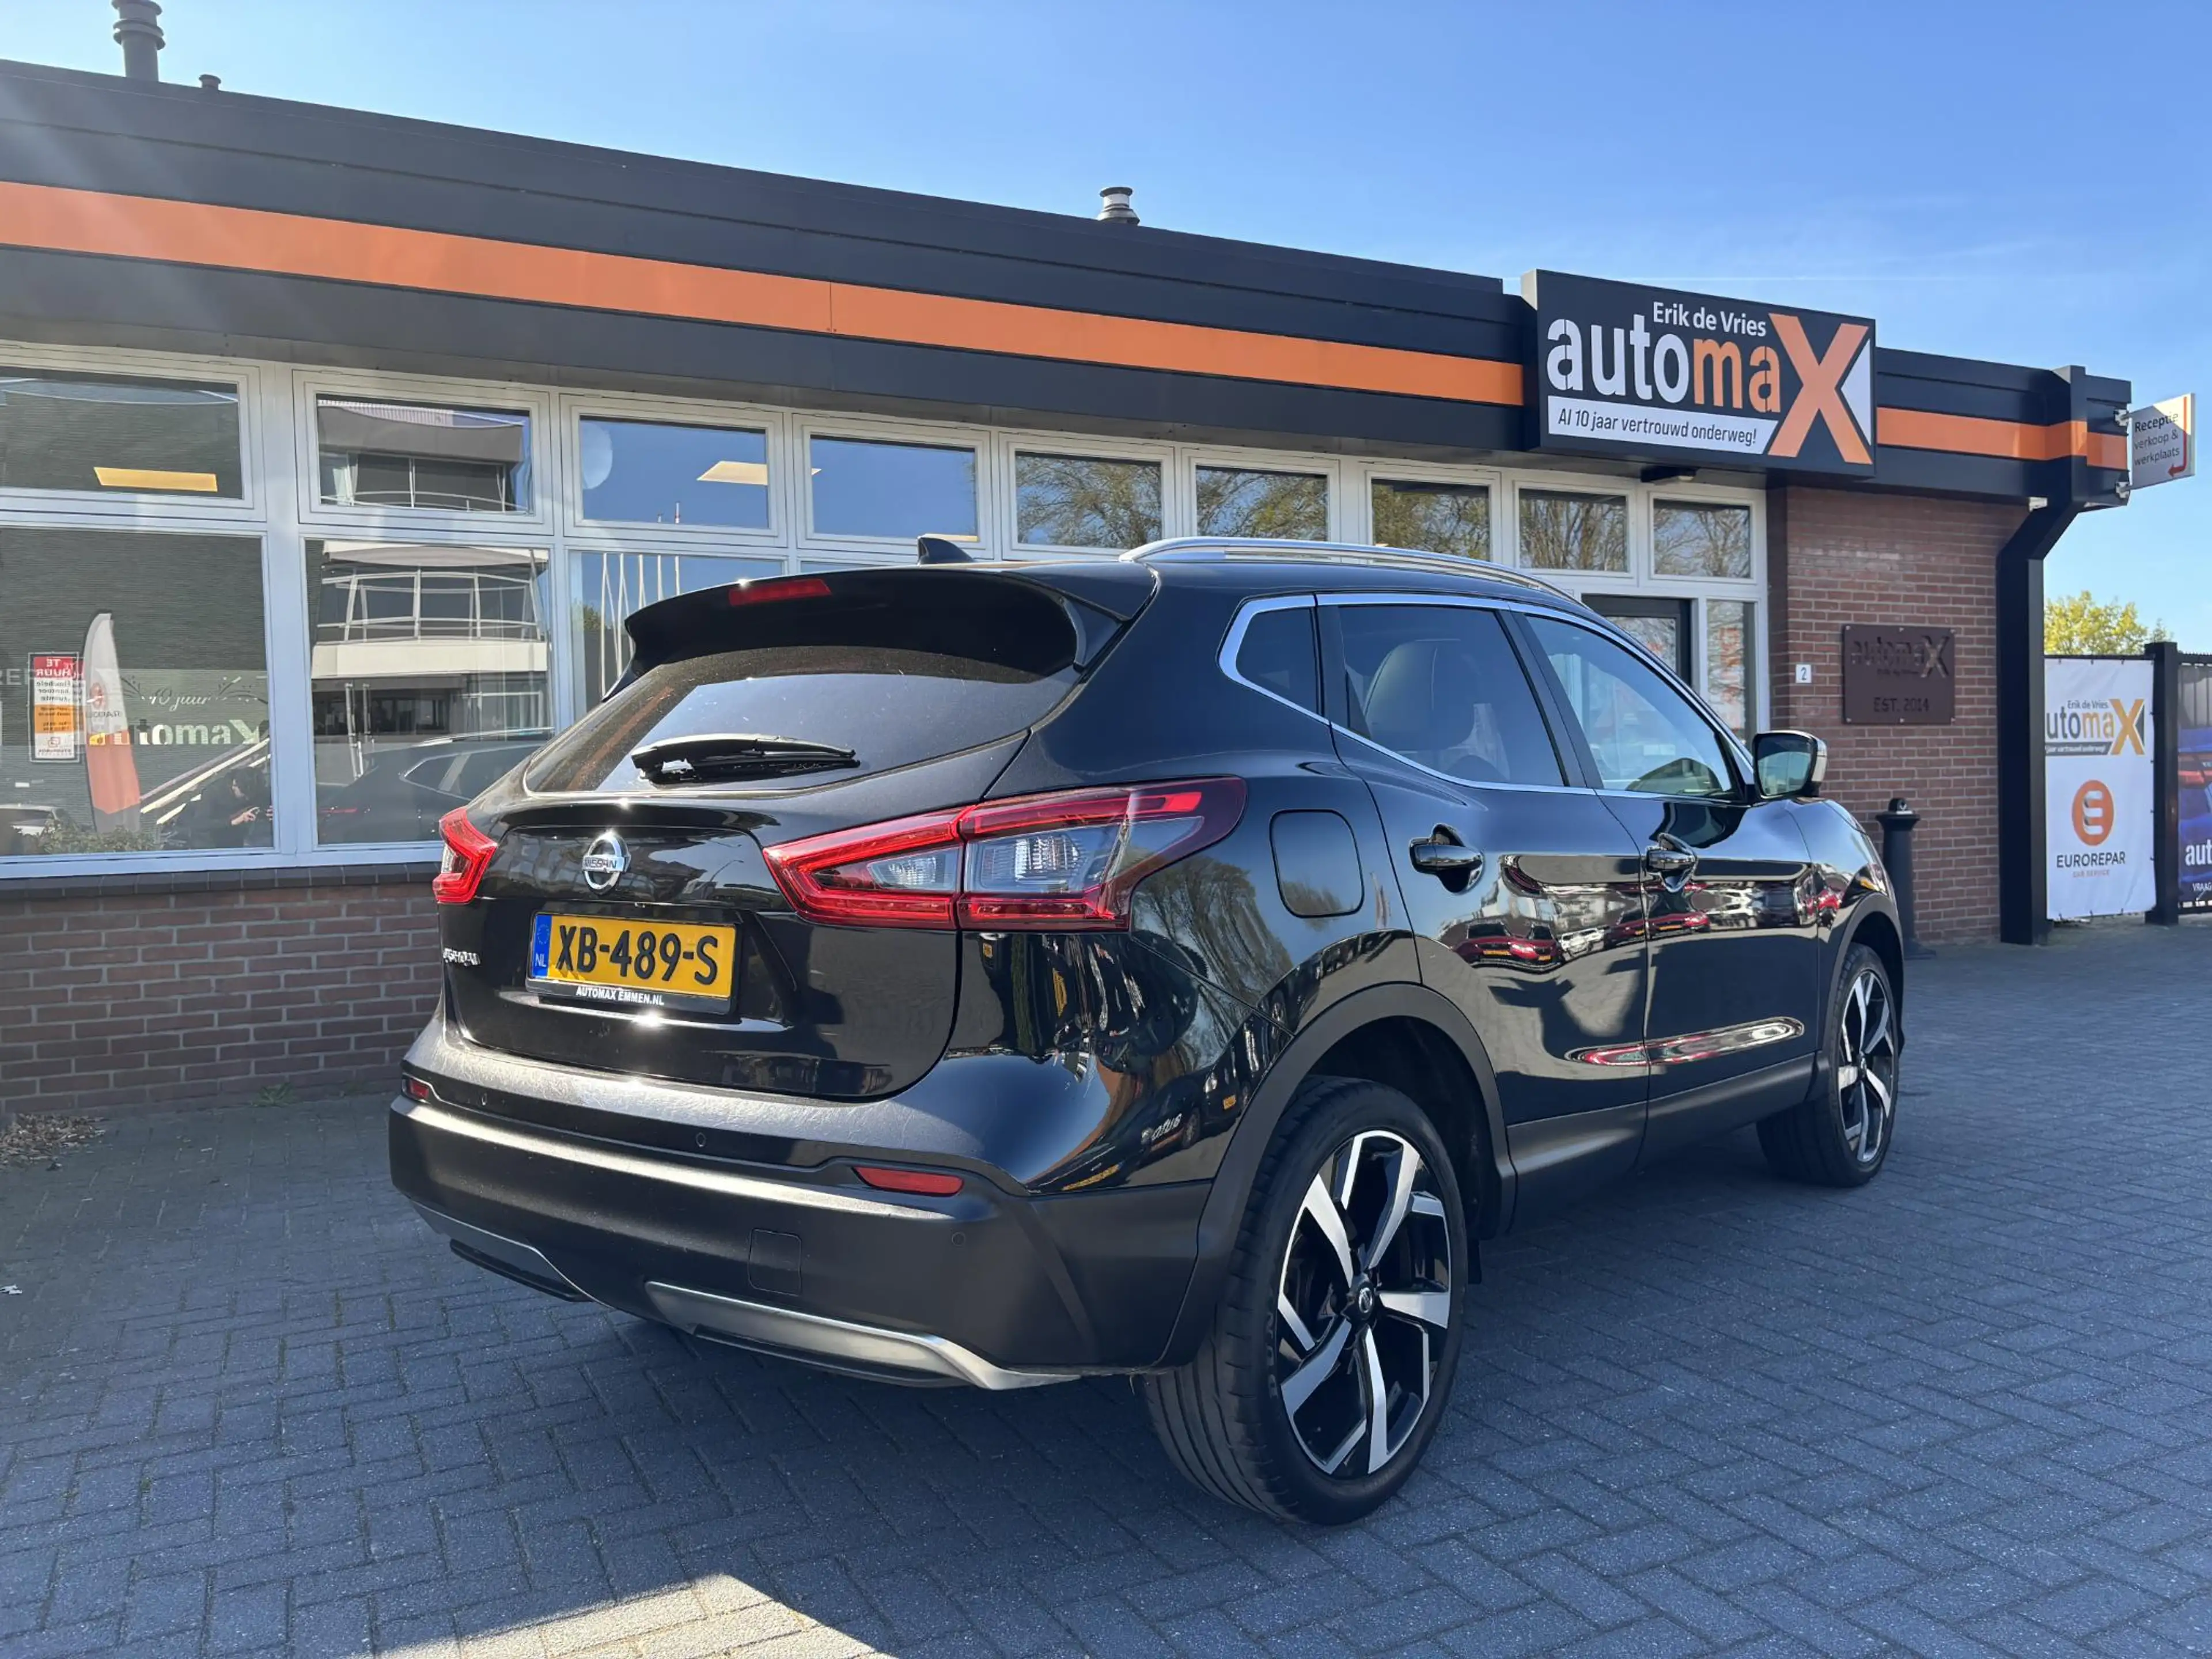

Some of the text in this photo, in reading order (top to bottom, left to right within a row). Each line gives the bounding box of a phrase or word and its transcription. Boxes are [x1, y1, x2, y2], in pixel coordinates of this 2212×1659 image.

[1653, 301, 1767, 337] Erik de Vries
[1547, 313, 1872, 465] automaX
[1575, 410, 1589, 427] 10
[1591, 411, 1619, 432] jaar
[1621, 418, 1689, 438] vertrouwd
[1691, 424, 1757, 447] onderweg!
[2135, 414, 2179, 433] Receptie
[2134, 429, 2179, 449] verkoop &
[2134, 447, 2180, 466] werkplaats
[1801, 666, 1807, 681] 2
[1874, 698, 1929, 713] EST. 2014
[2067, 700, 2081, 709] Erik
[2082, 700, 2090, 709] de
[2046, 699, 2145, 756] utomaX
[2056, 851, 2126, 868] EUROREPAR
[535, 953, 547, 967] NL
[556, 925, 718, 985] XB-489-S
[576, 986, 665, 1006] AUTOMAX EMMEN.NL
